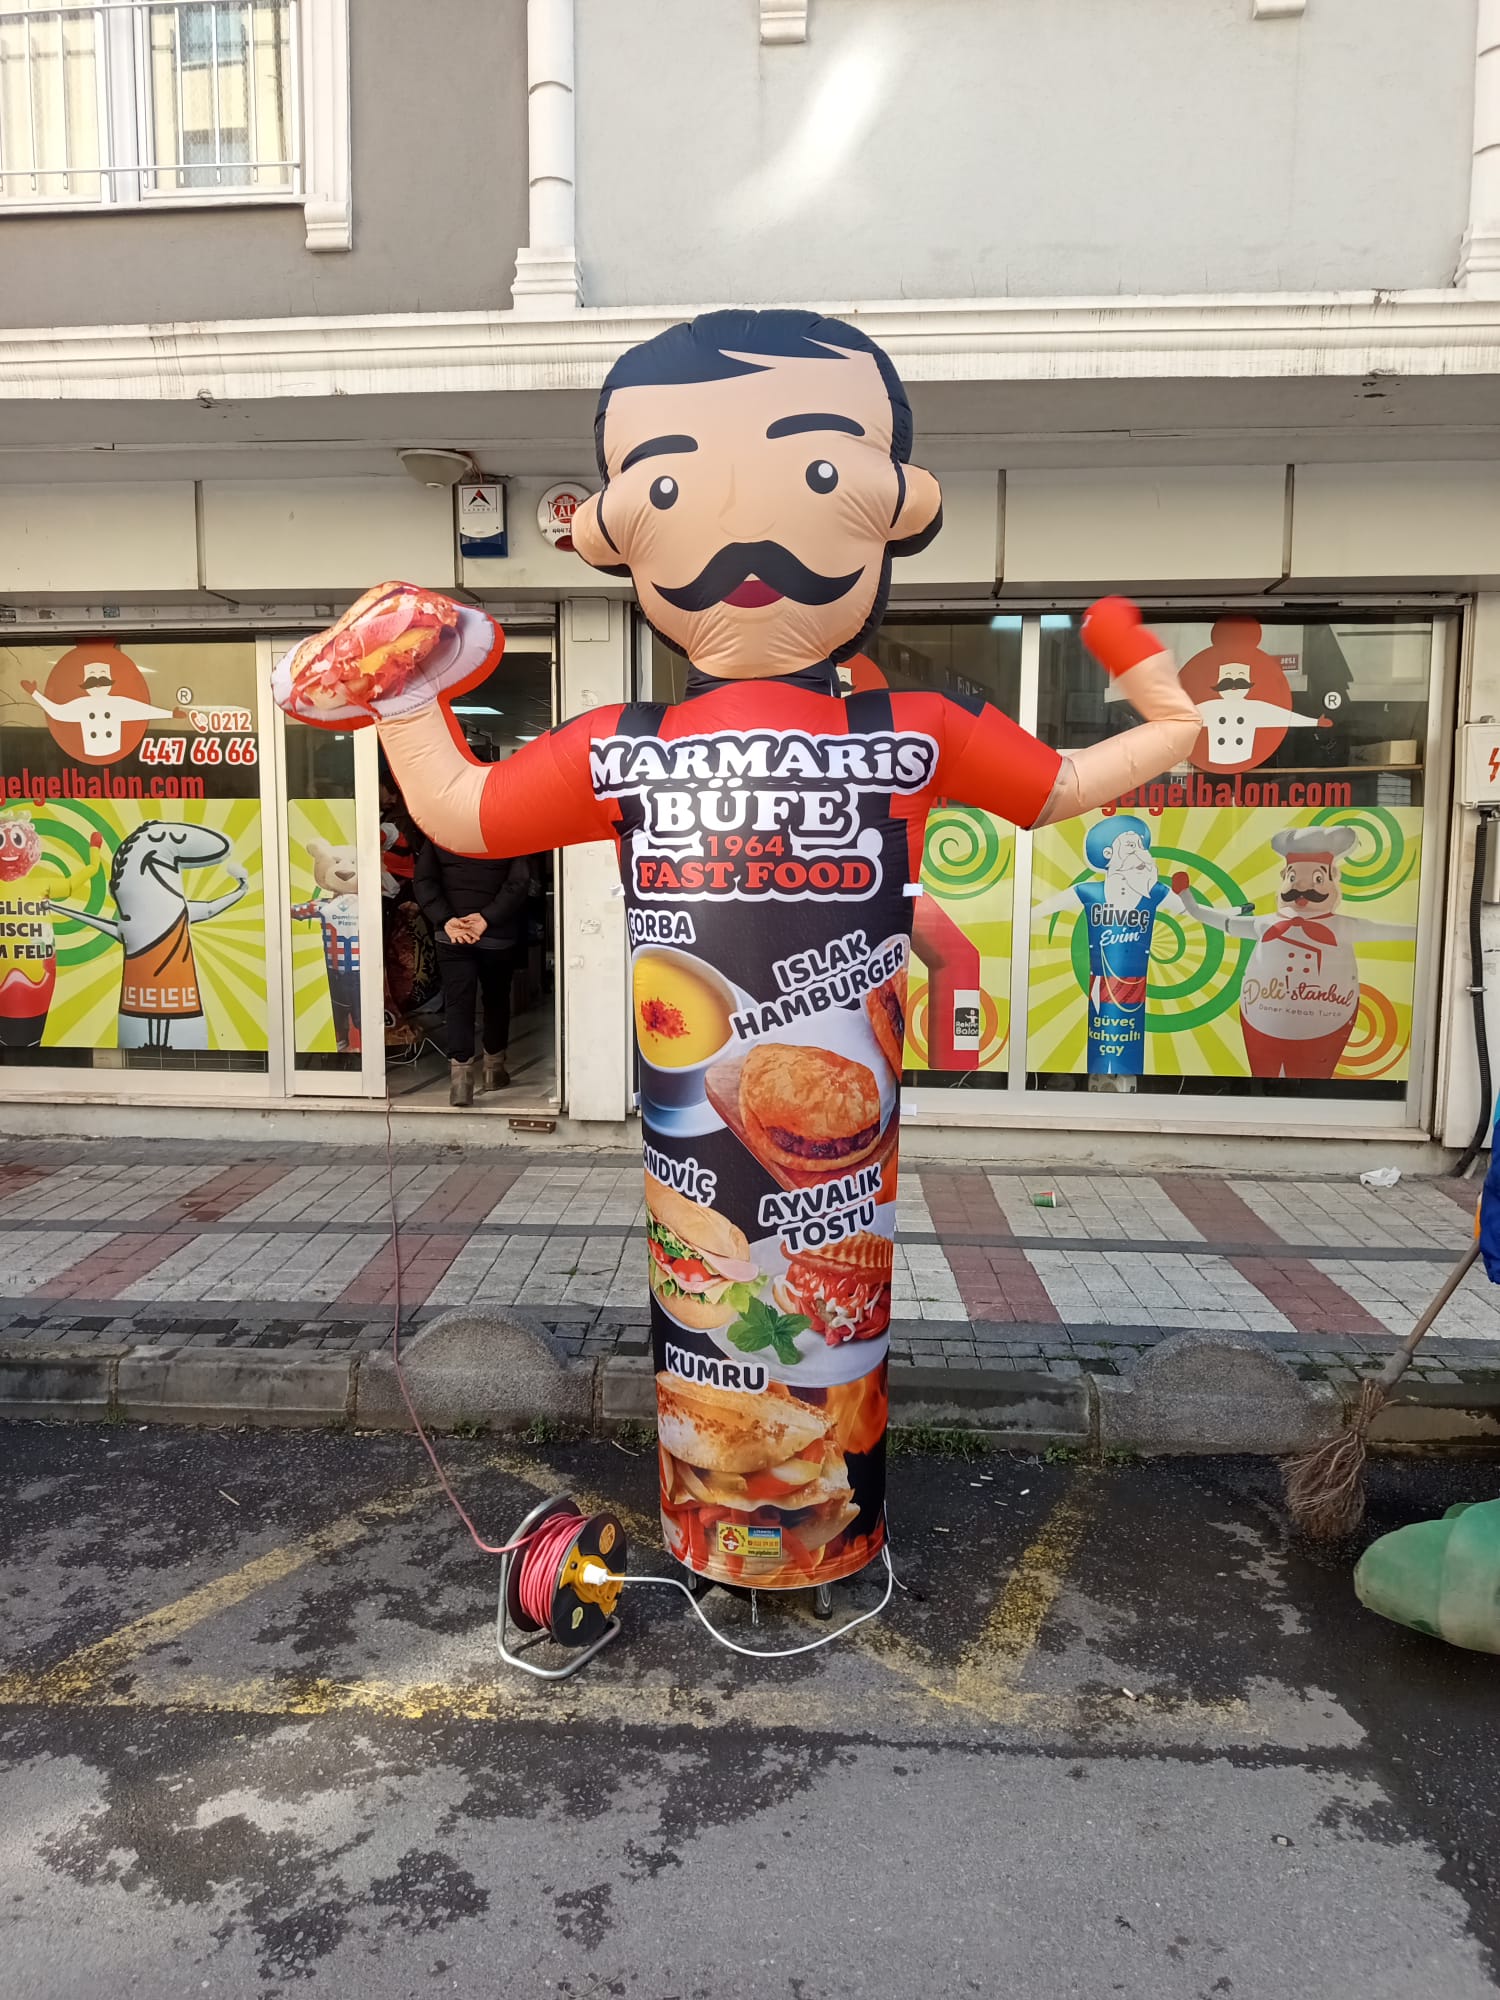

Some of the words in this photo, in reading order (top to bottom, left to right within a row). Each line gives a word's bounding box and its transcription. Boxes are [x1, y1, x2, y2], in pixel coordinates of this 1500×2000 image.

[211, 712, 250, 731] 0212
[140, 739, 186, 763] 447
[192, 739, 221, 763] 66
[227, 739, 256, 763] 66
[650, 778, 850, 836] BÜFE
[707, 836, 784, 857] 1964
[638, 861, 734, 889] FAST
[745, 861, 871, 889] FOOD
[628, 910, 694, 944] ÇORBA
[1091, 903, 1149, 933] Güveç
[1100, 927, 1140, 946] Evim
[13, 944, 54, 959] FELD
[775, 932, 871, 989] ISLAK
[732, 942, 905, 1040] HAMBURGER
[1093, 1015, 1136, 1029] güveç
[1099, 1045, 1125, 1057] çay
[761, 1166, 882, 1223] AYVALIK
[781, 1200, 876, 1251] TOSTU
[665, 1346, 767, 1391] KUMRU
